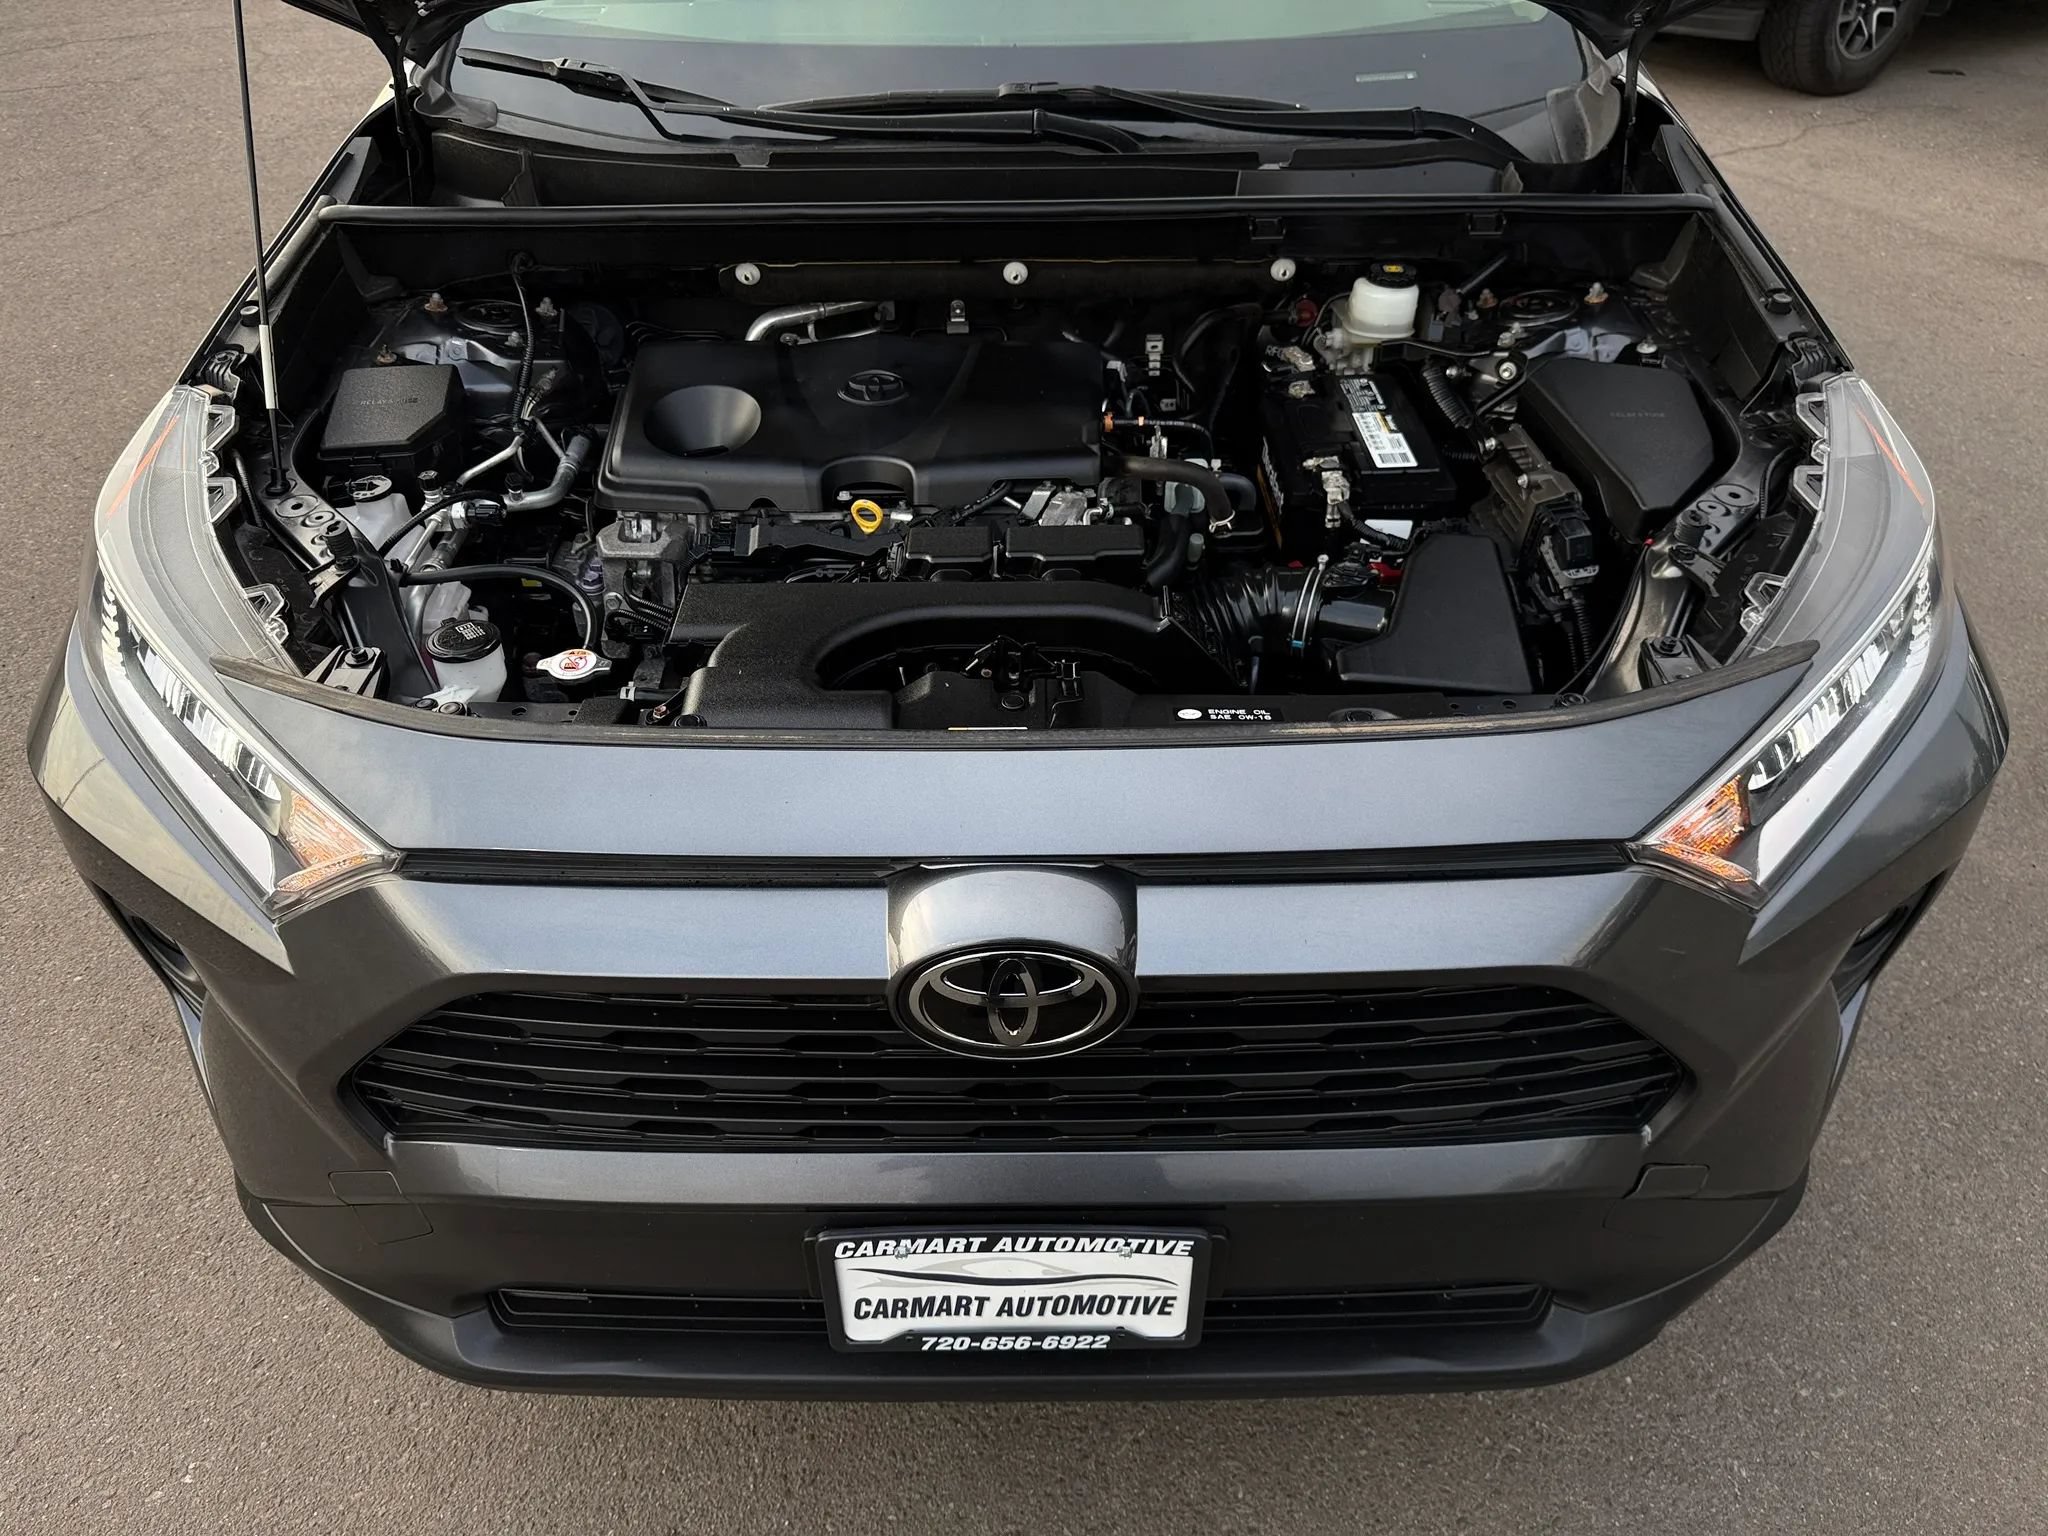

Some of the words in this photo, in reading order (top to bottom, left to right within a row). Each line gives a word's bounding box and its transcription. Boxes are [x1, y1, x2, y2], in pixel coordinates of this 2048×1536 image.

[834, 1237, 987, 1259] CARMART
[991, 1237, 1195, 1256] AUTOMOTIVE
[854, 1295, 990, 1320] CARMART
[995, 1294, 1178, 1317] AUTOMOTIVE
[920, 1335, 1111, 1351] 720-656-6922
